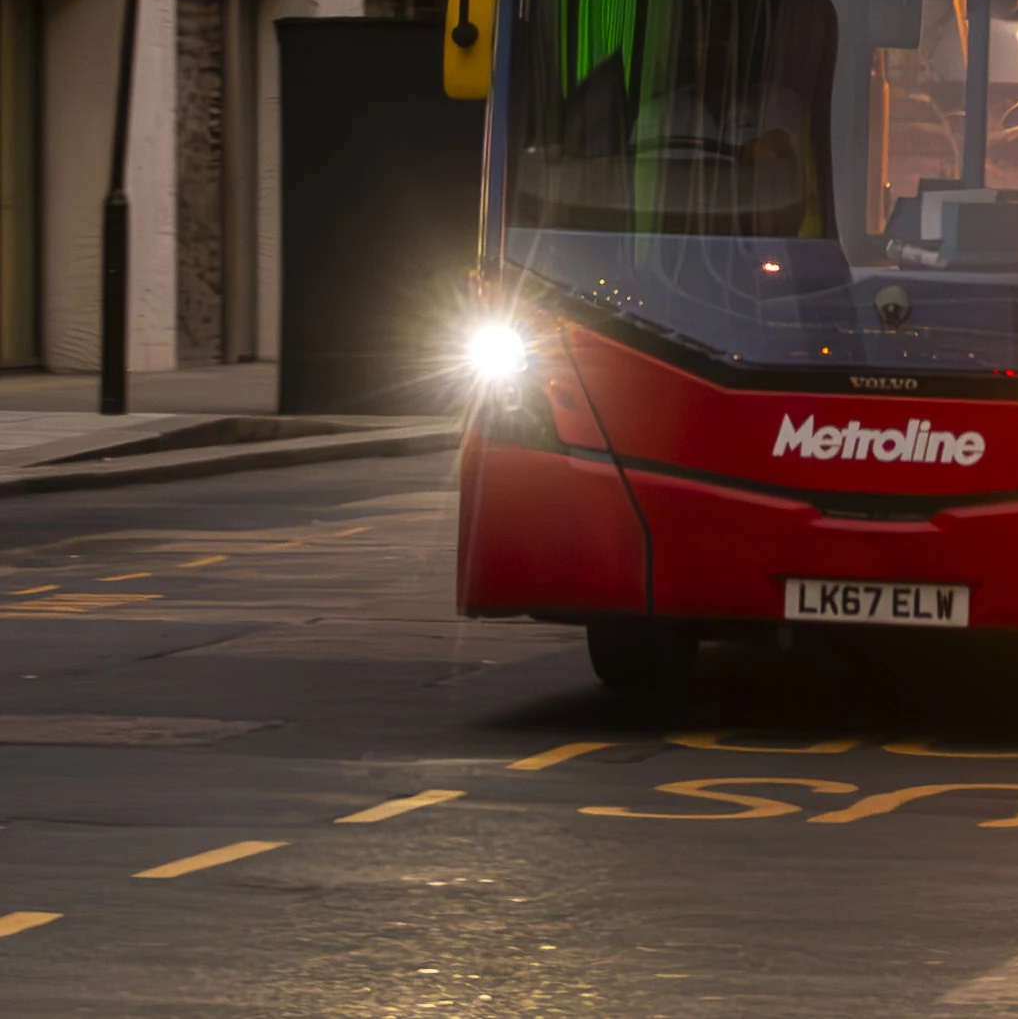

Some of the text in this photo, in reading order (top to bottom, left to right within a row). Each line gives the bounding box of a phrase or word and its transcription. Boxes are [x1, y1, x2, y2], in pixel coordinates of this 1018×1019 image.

[849, 376, 918, 390] VOLVO
[772, 413, 986, 467] Metroline
[799, 584, 954, 621] LK67 ELW
